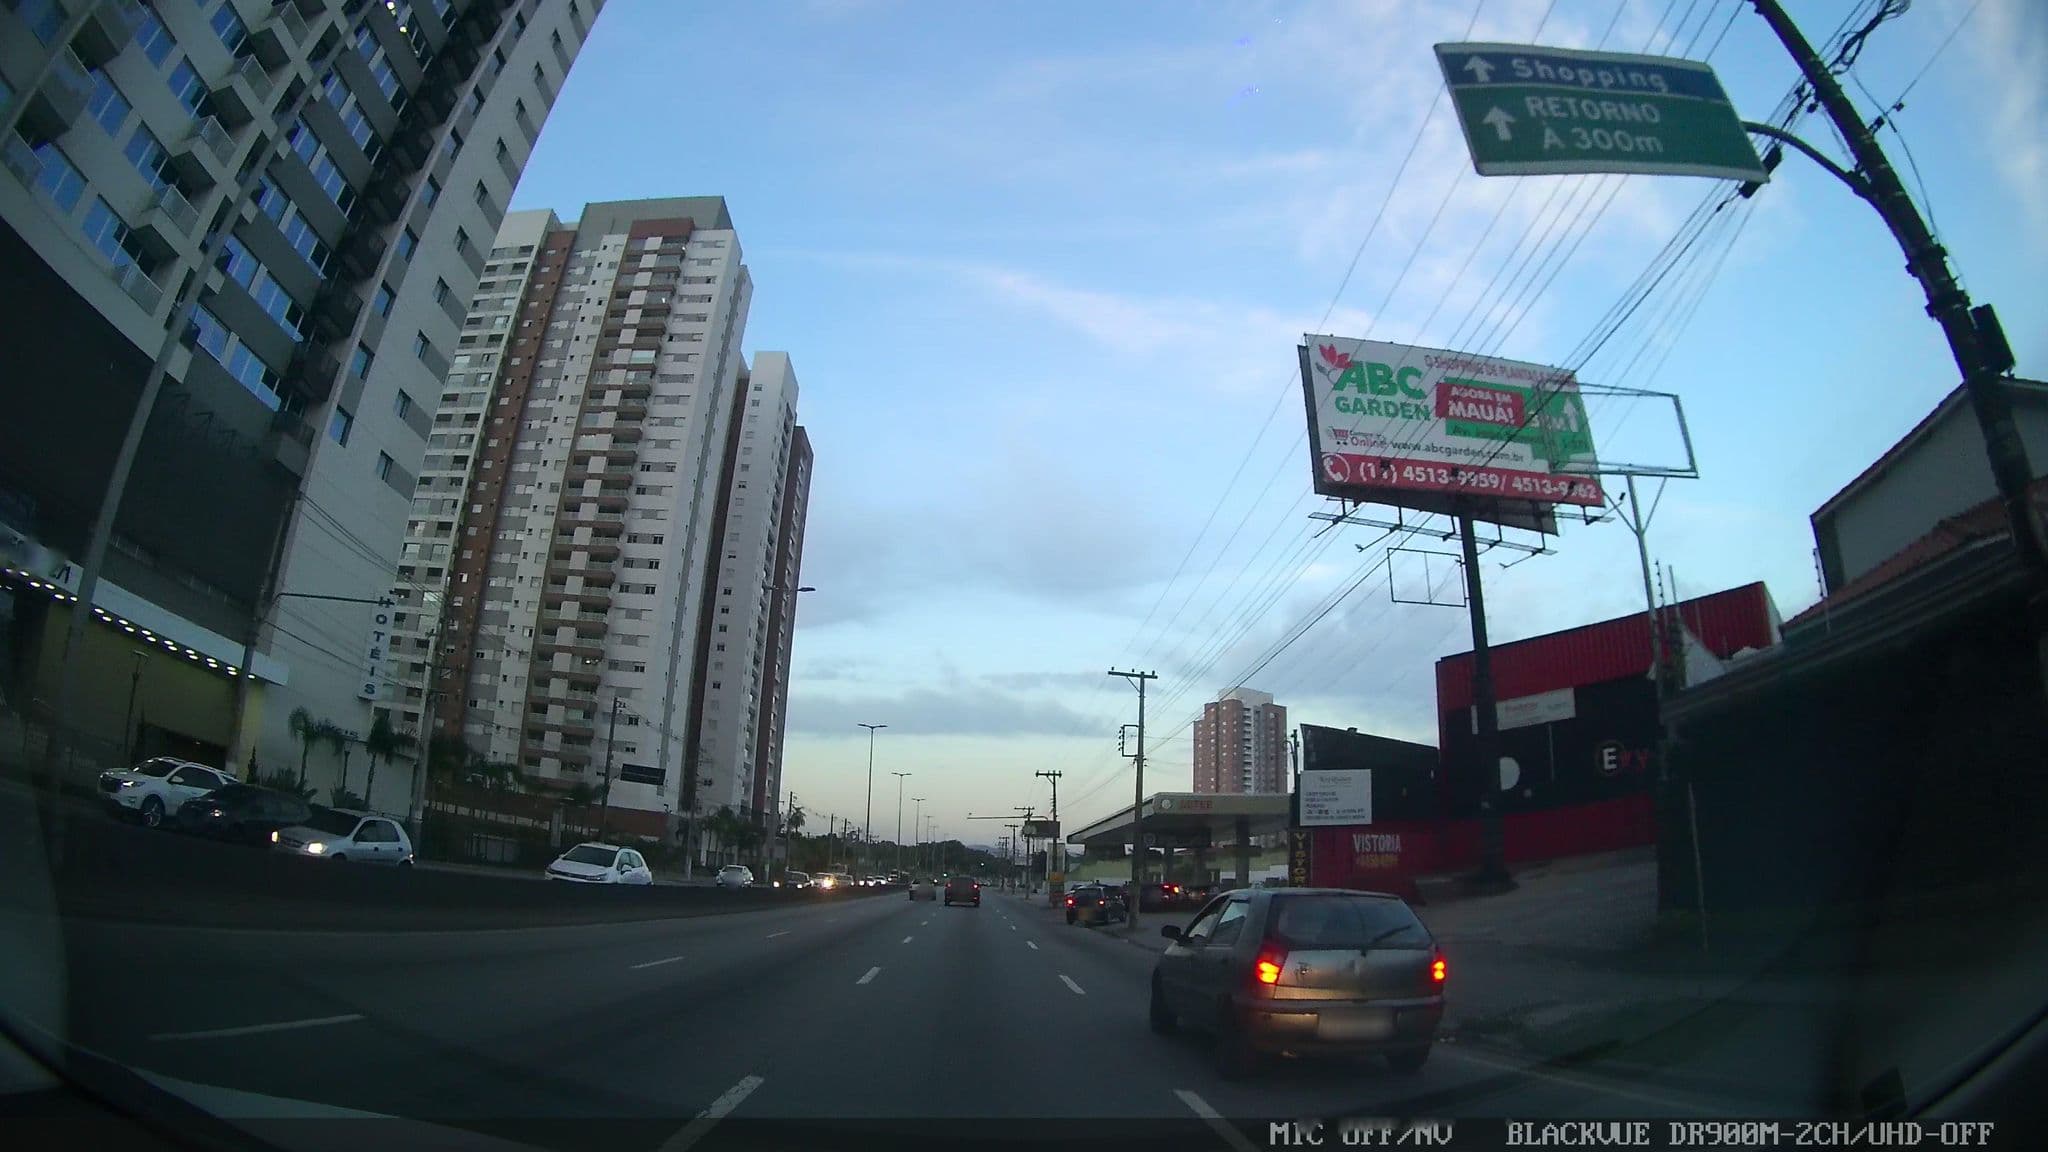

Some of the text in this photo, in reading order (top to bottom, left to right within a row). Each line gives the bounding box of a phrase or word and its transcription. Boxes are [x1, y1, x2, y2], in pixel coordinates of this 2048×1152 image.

[1511, 58, 1668, 93] Shopping
[1524, 96, 1661, 123] RETORNO
[1572, 127, 1663, 152] 300m
[1334, 360, 1427, 400] ABC
[1451, 386, 1493, 400] AGORA
[1335, 396, 1430, 421] GARDEN
[1448, 400, 1515, 425] MAUÁ!
[1352, 834, 1402, 853] VISTORIA
